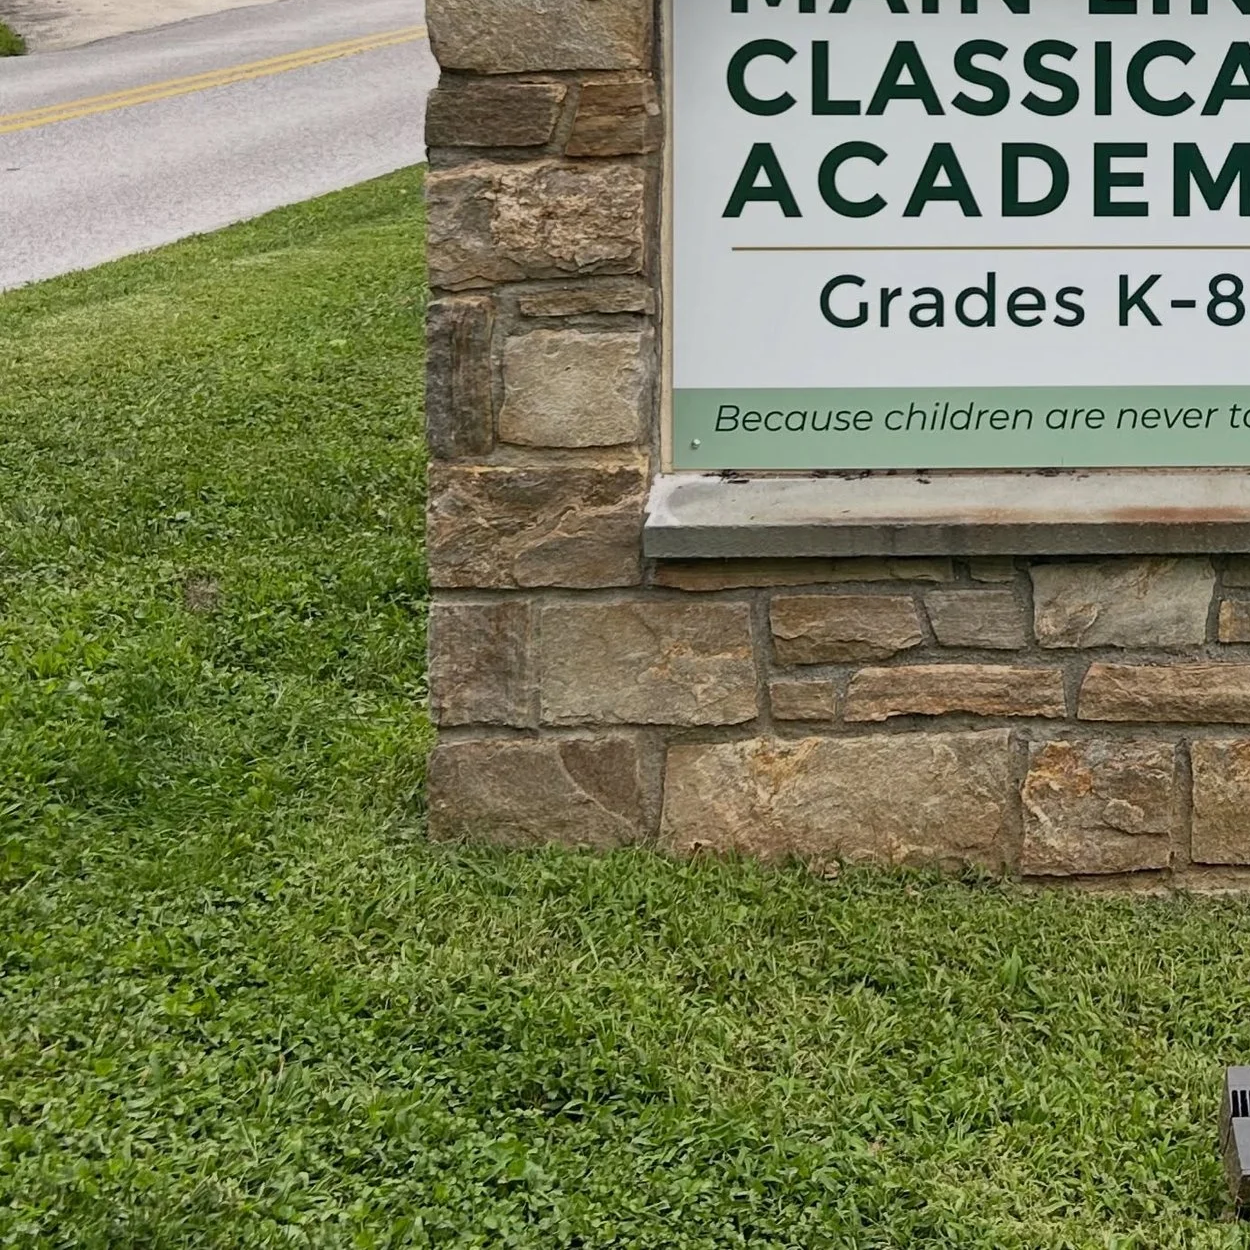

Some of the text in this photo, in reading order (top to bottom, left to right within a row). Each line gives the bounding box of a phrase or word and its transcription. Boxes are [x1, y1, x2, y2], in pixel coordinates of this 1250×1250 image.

[819, 271, 1247, 329] Grades K-8
[714, 404, 874, 433] Because
[884, 402, 1034, 432] children
[1045, 407, 1105, 431] are
[1116, 406, 1219, 430] never
